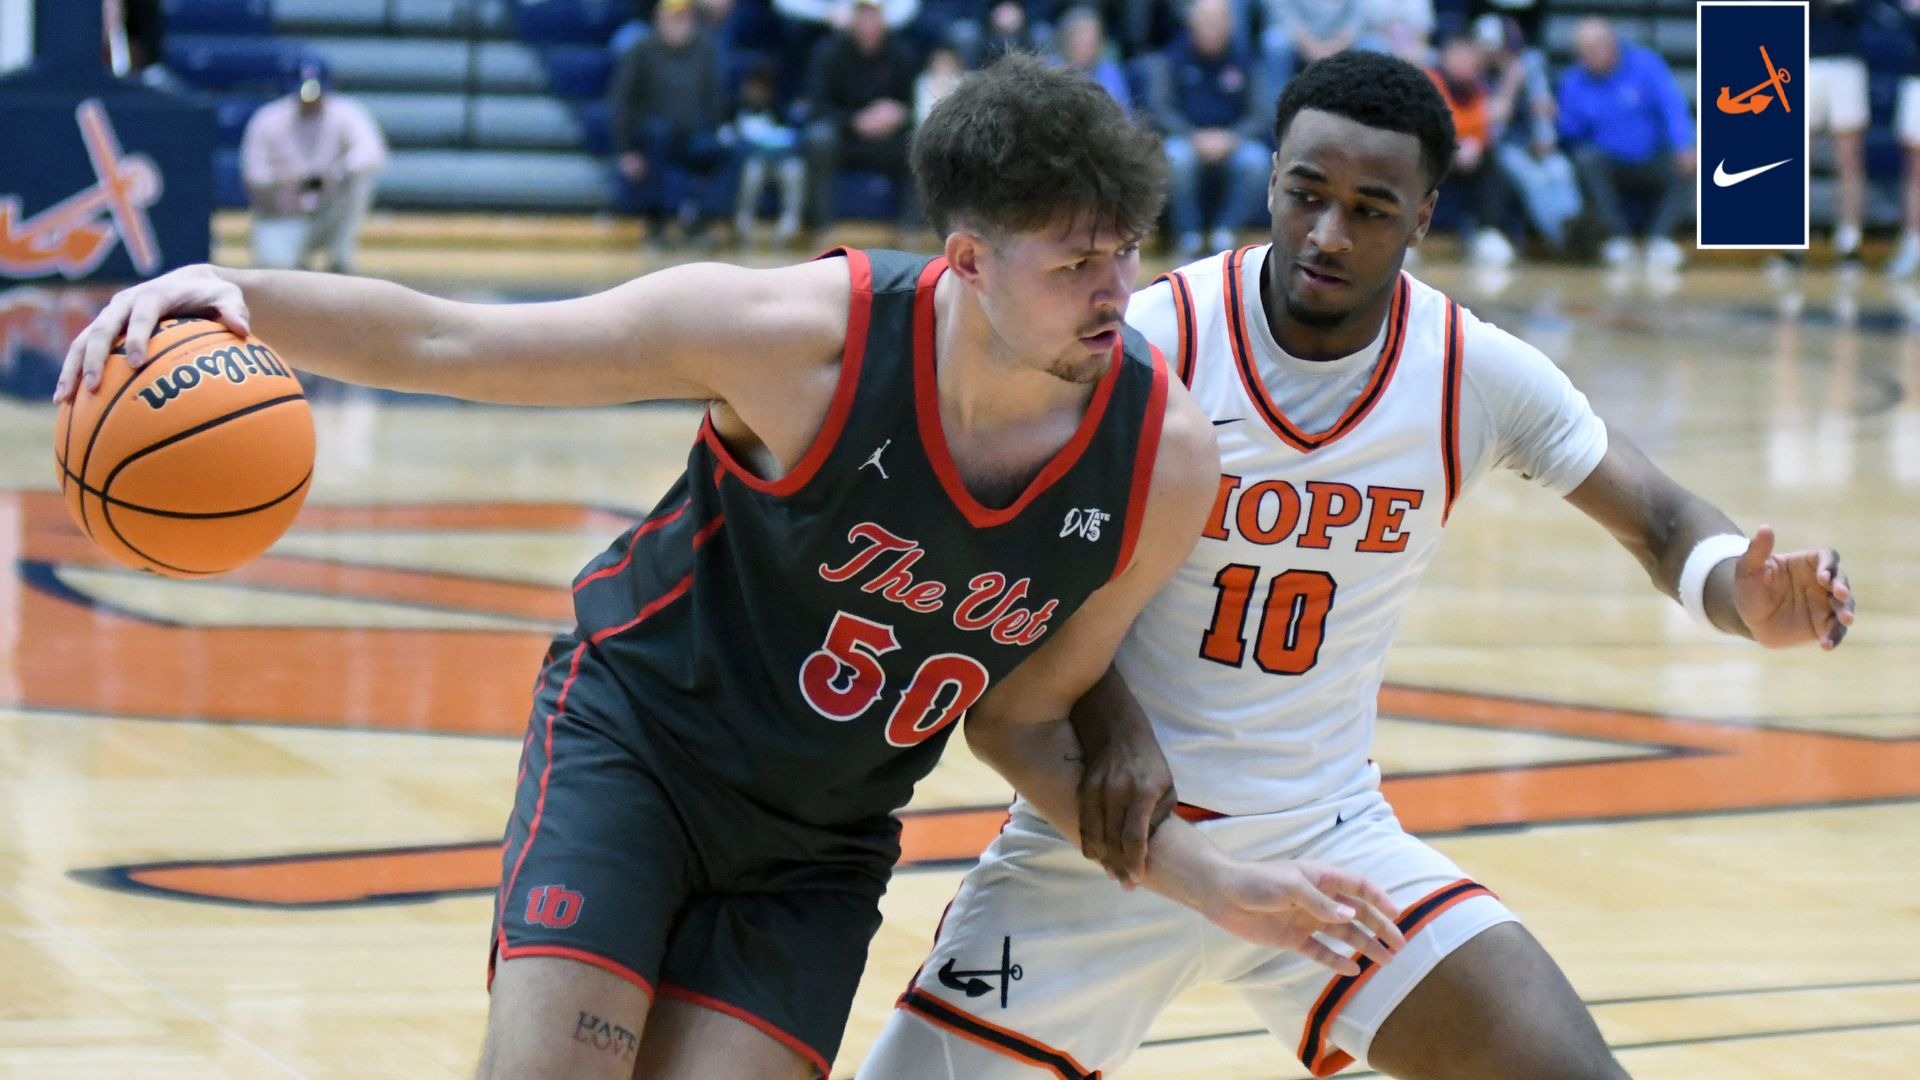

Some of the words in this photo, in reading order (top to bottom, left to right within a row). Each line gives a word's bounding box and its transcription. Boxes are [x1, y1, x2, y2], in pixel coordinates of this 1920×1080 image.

[138, 342, 291, 409] Wilson
[818, 522, 946, 613] The
[953, 572, 1059, 646] Vet
[1199, 563, 1337, 676] 10
[799, 610, 989, 747] 50
